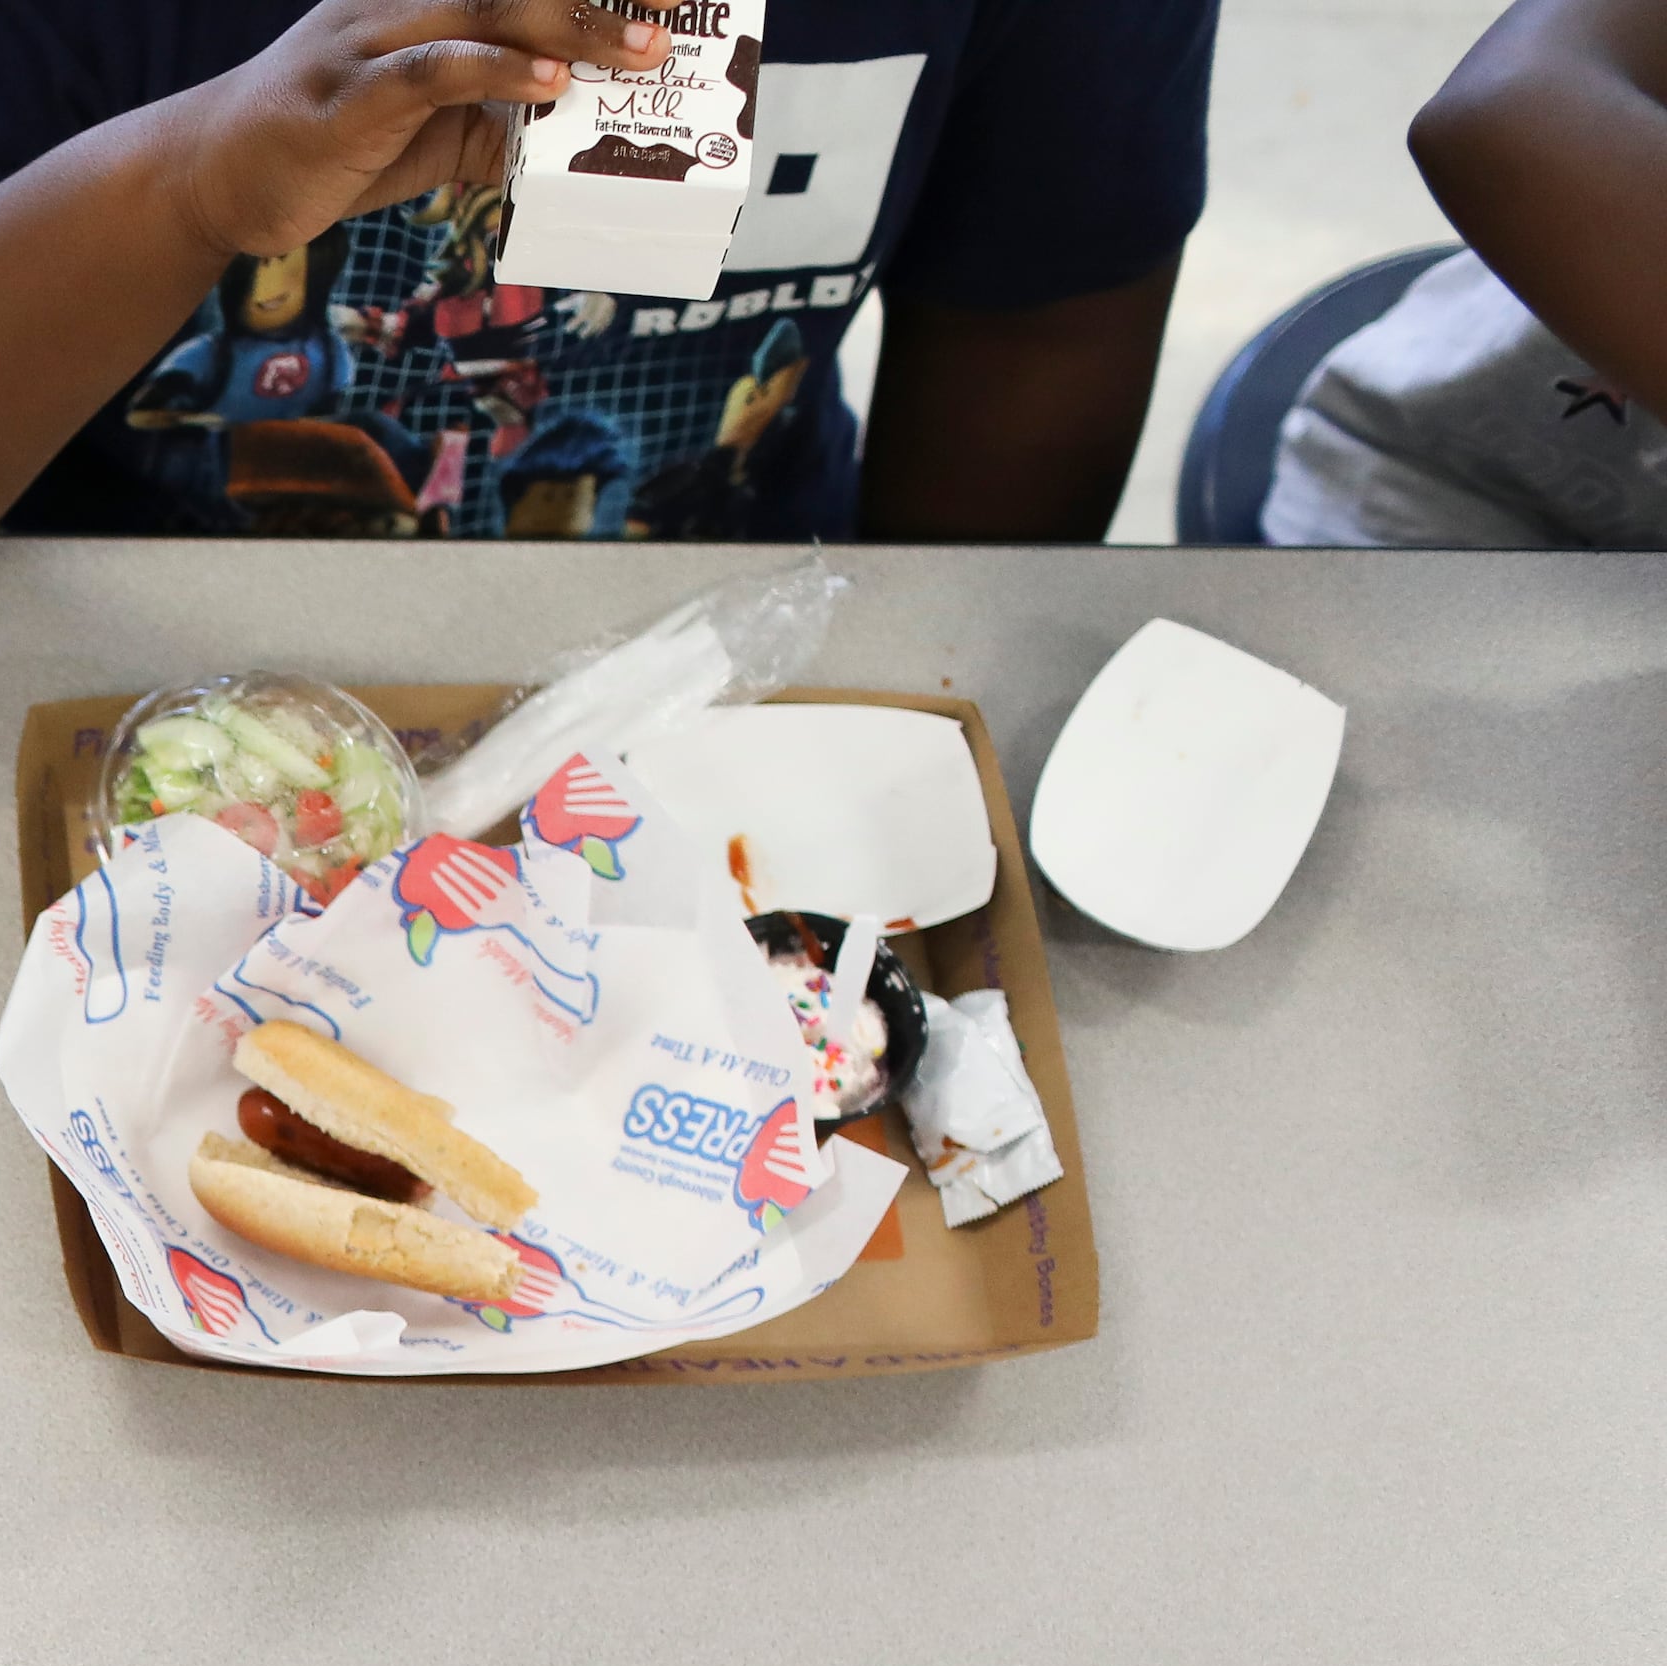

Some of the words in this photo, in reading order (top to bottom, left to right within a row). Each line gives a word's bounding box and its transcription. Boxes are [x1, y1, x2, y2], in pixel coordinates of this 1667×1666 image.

[597, 87, 683, 120] Milk
[595, 119, 632, 133] Fat-Free
[634, 123, 671, 138] Flavored
[673, 126, 693, 139] Milk
[148, 859, 169, 875] &
[154, 881, 175, 931] Body
[144, 932, 168, 1003] Feeding
[650, 1033, 696, 1062] Time
[742, 1059, 792, 1087] Child
[623, 1082, 770, 1169] PRESS
[611, 1155, 656, 1184] County
[1038, 1257, 1056, 1327] Bones
